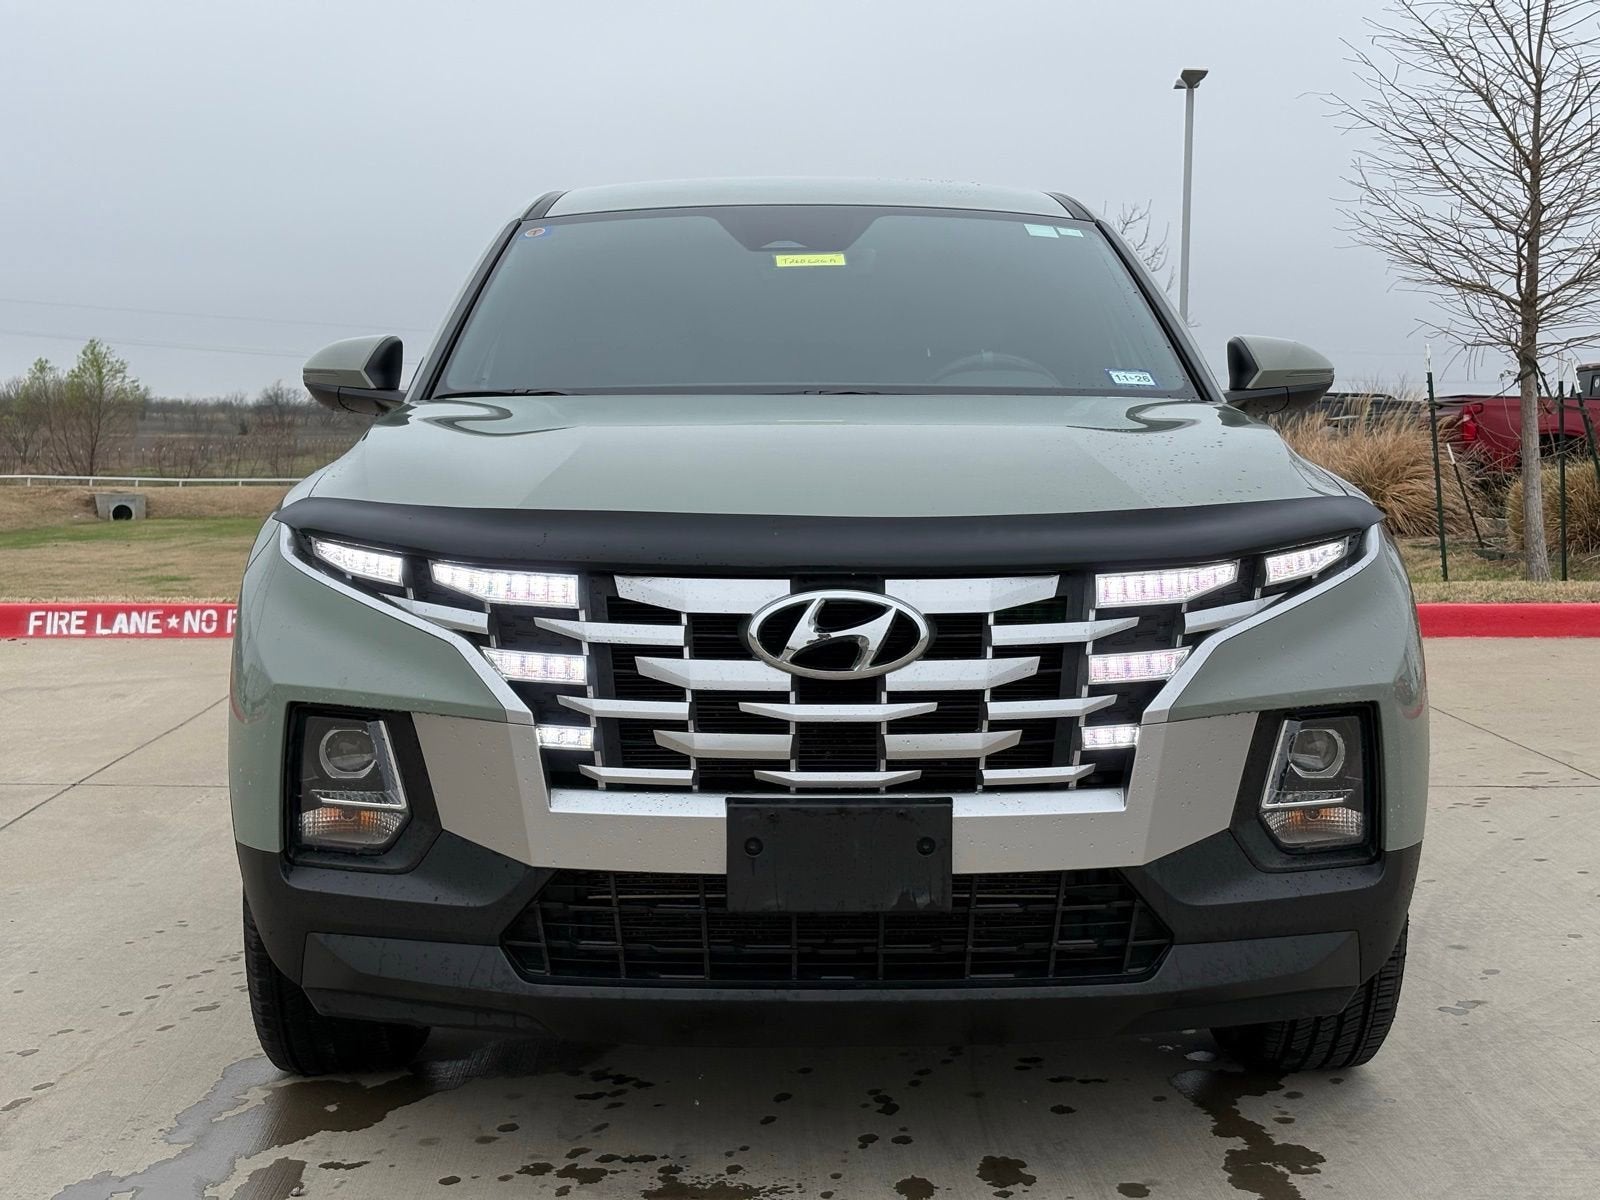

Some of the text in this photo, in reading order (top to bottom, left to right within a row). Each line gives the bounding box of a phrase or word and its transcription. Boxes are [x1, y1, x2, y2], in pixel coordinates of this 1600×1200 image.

[28, 611, 87, 635] FIRE
[96, 610, 163, 635] LANE
[183, 609, 218, 634] NO
